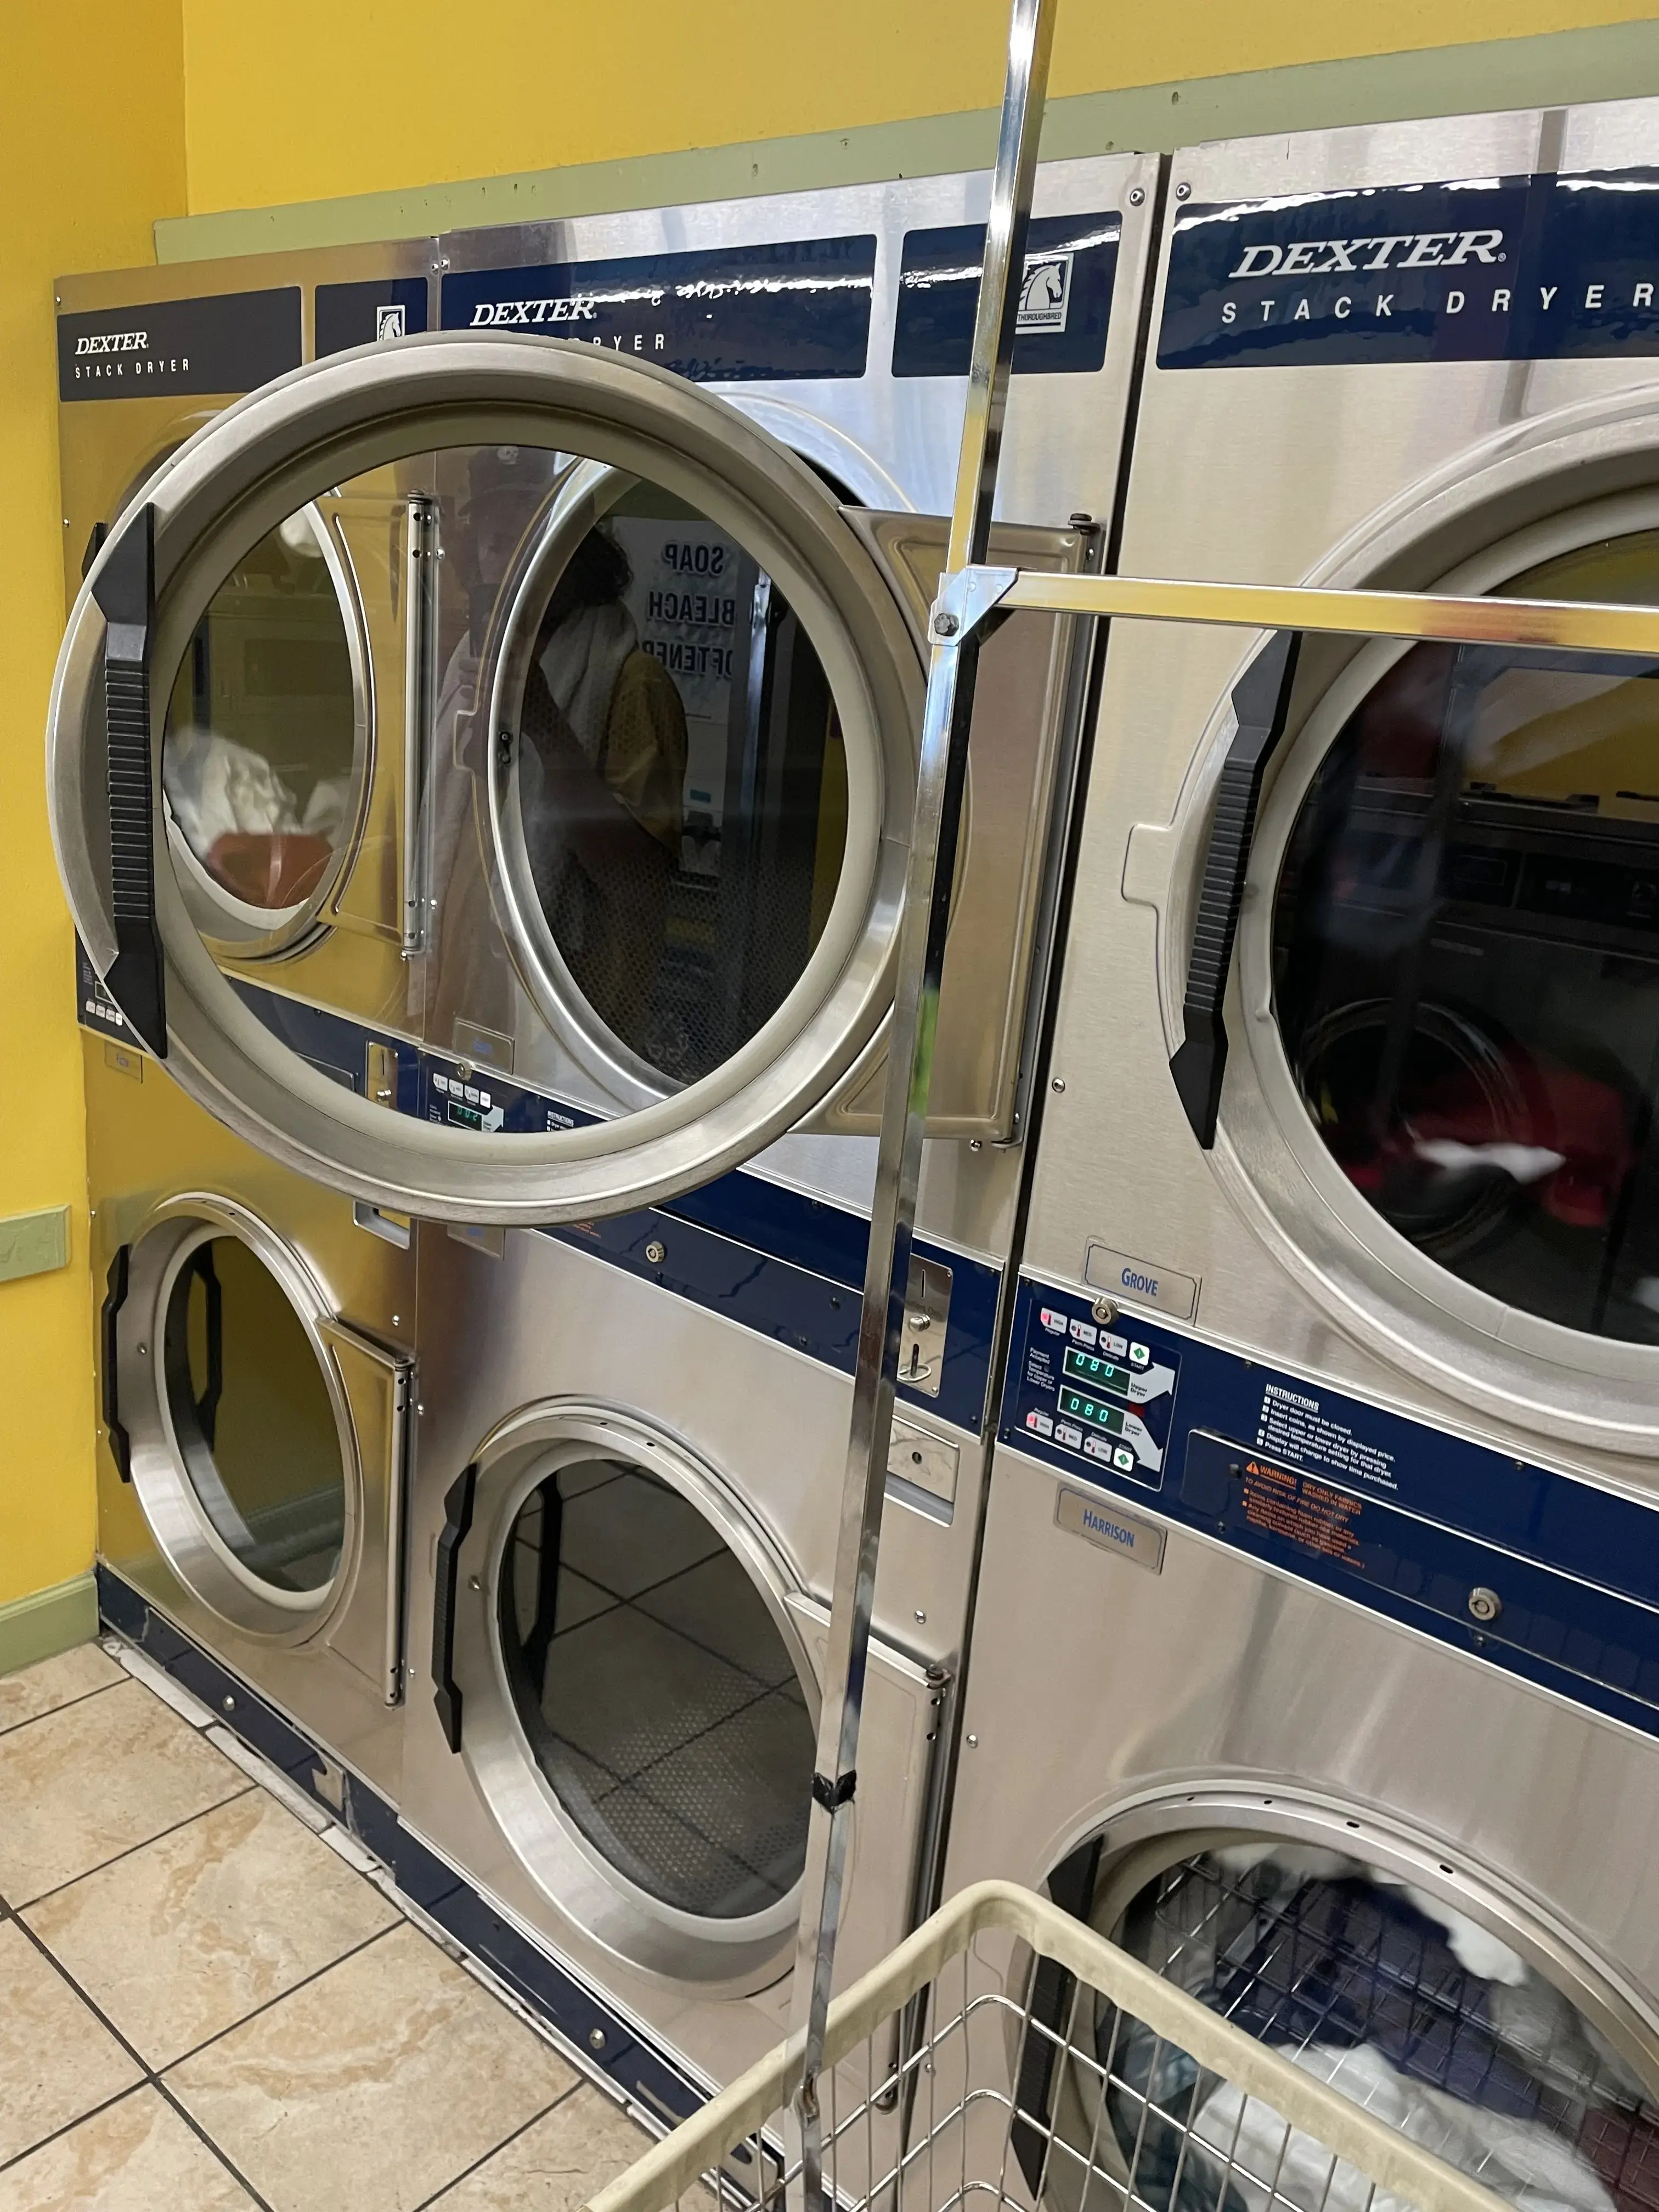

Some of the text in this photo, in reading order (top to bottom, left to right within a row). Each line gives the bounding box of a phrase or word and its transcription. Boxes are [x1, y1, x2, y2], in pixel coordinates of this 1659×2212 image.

[1228, 229, 1503, 278] DEXTER
[470, 300, 595, 326] DEXTER
[1222, 283, 1654, 323] STACK DRYER
[75, 331, 148, 355] DEXTER
[75, 359, 189, 379] STACK DRYER
[1121, 1268, 1158, 1297] GROVE
[1076, 1353, 1114, 1377] 080
[1070, 1397, 1108, 1422] 080
[1266, 1383, 1319, 1411] INSTRUCTIONS
[1272, 1400, 1289, 1410] Dryer
[1290, 1407, 1304, 1417] door
[1305, 1413, 1321, 1424] must
[1321, 1419, 1329, 1427] be
[1269, 1417, 1288, 1430] Select
[1288, 1426, 1306, 1436] upper
[1314, 1435, 1331, 1446] lower
[1333, 1443, 1349, 1453] dryer
[1350, 1449, 1358, 1458] by
[1359, 1454, 1387, 1469] pressing
[1271, 1408, 1288, 1420] Insert
[1317, 1427, 1336, 1440] shown
[1338, 1435, 1346, 1443] by
[1347, 1439, 1377, 1454] displayed
[1265, 1441, 1282, 1453] Press
[1266, 1432, 1288, 1447] Display
[1300, 1447, 1322, 1460] change
[1331, 1459, 1348, 1470] show
[1260, 1465, 1297, 1487] WARNING!
[1350, 1456, 1359, 1464] for
[1361, 1460, 1373, 1470] that
[1084, 1509, 1135, 1548] HARRISON
